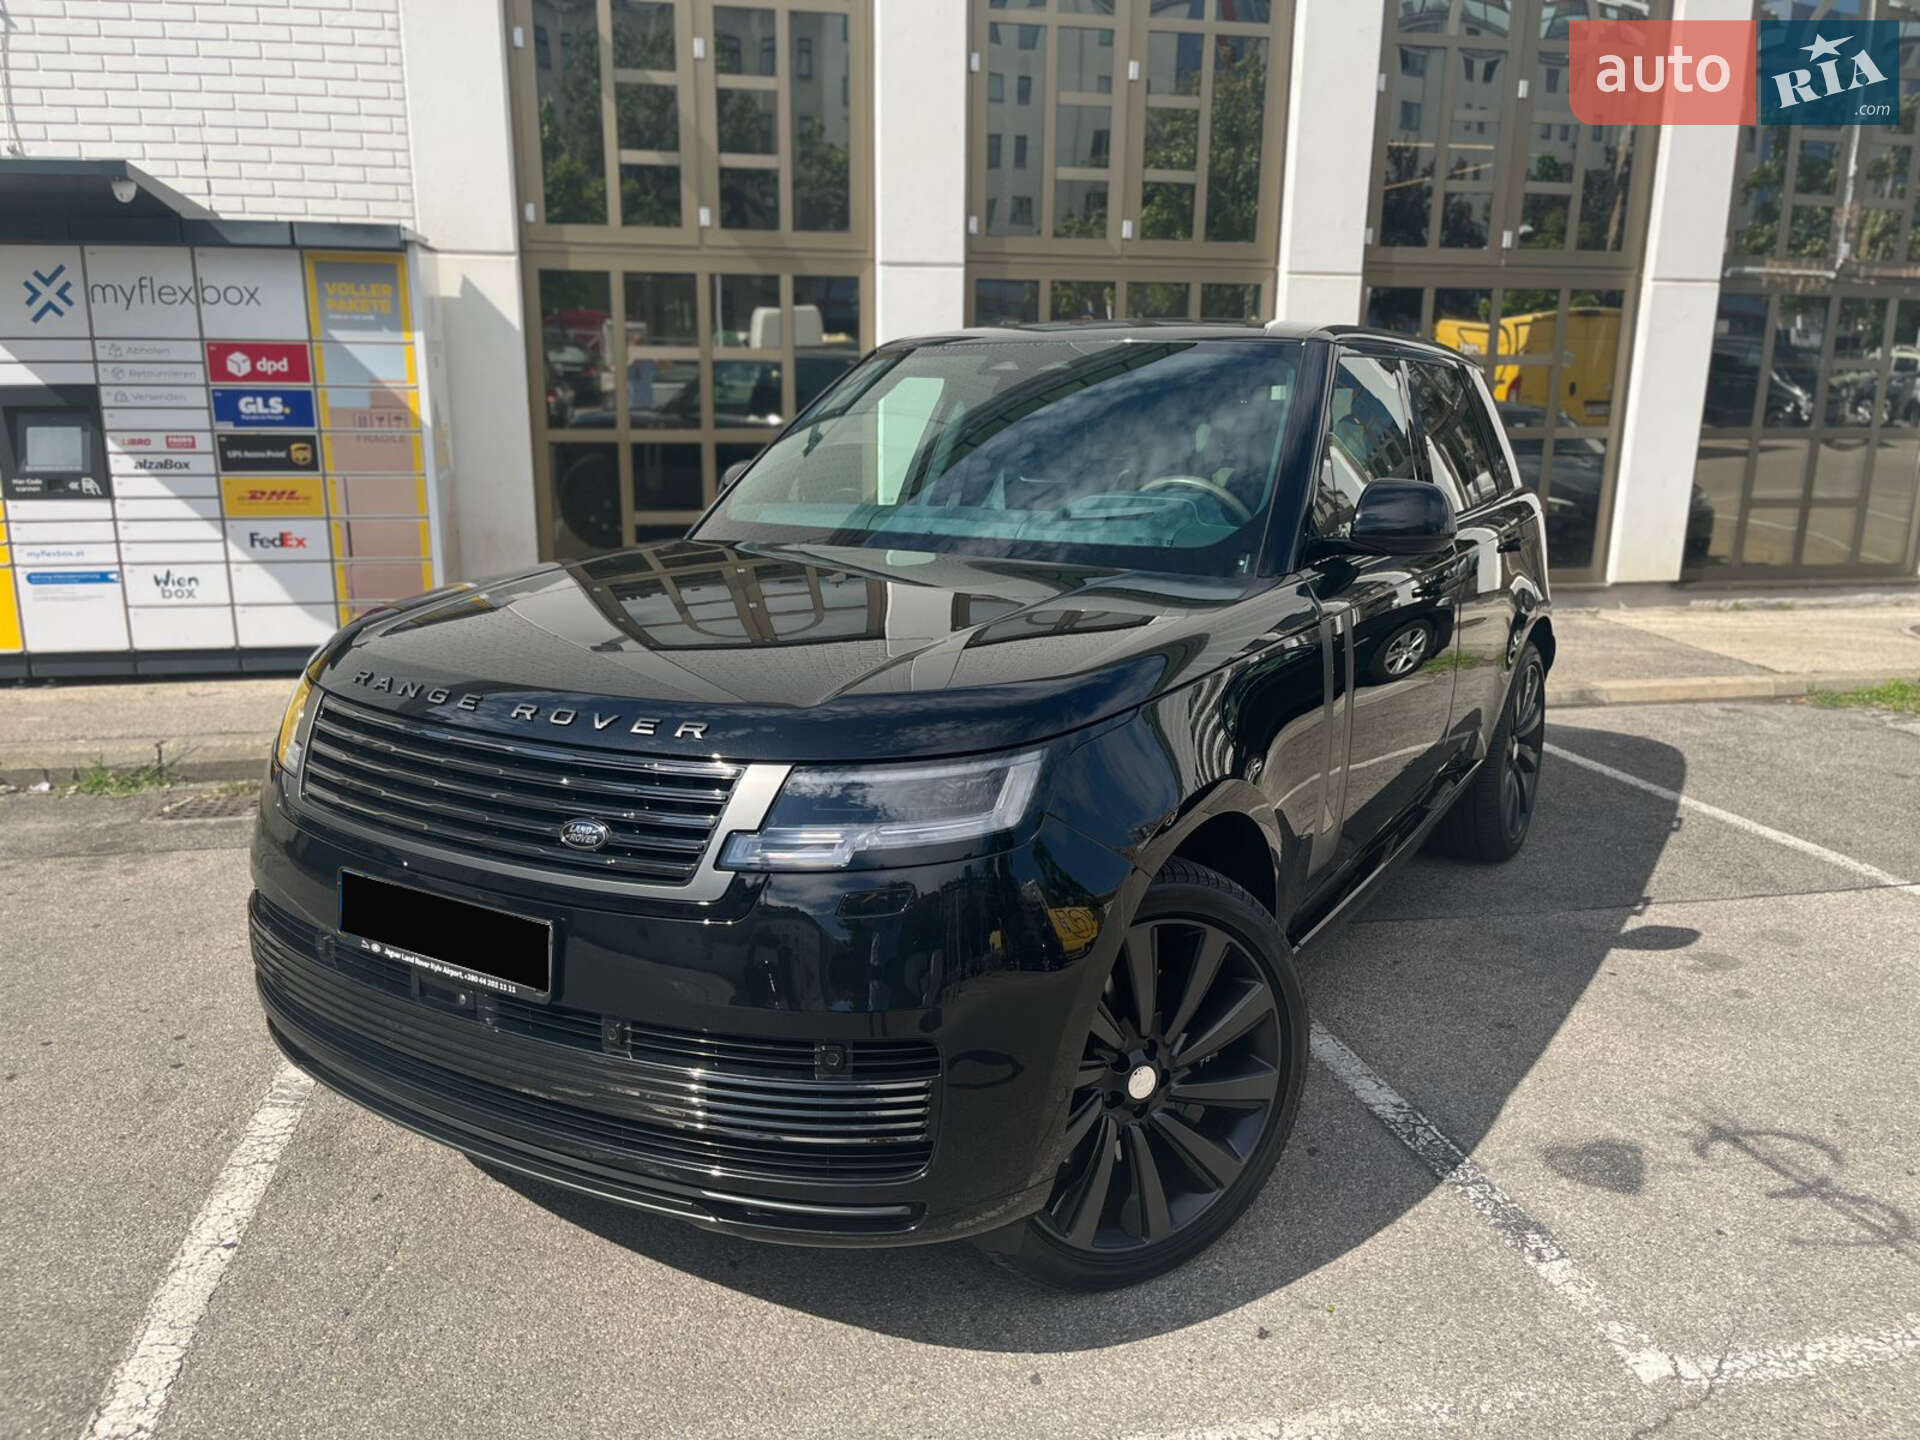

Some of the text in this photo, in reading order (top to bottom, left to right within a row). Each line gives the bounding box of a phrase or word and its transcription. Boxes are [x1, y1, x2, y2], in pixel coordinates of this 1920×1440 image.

[256, 357, 289, 375] dpd
[134, 458, 191, 471] alzaBox
[248, 490, 299, 501] DHL
[249, 532, 306, 548] FedEx
[153, 568, 199, 587] Wien
[161, 586, 197, 599] box
[352, 670, 710, 740] RANGE ROVER
